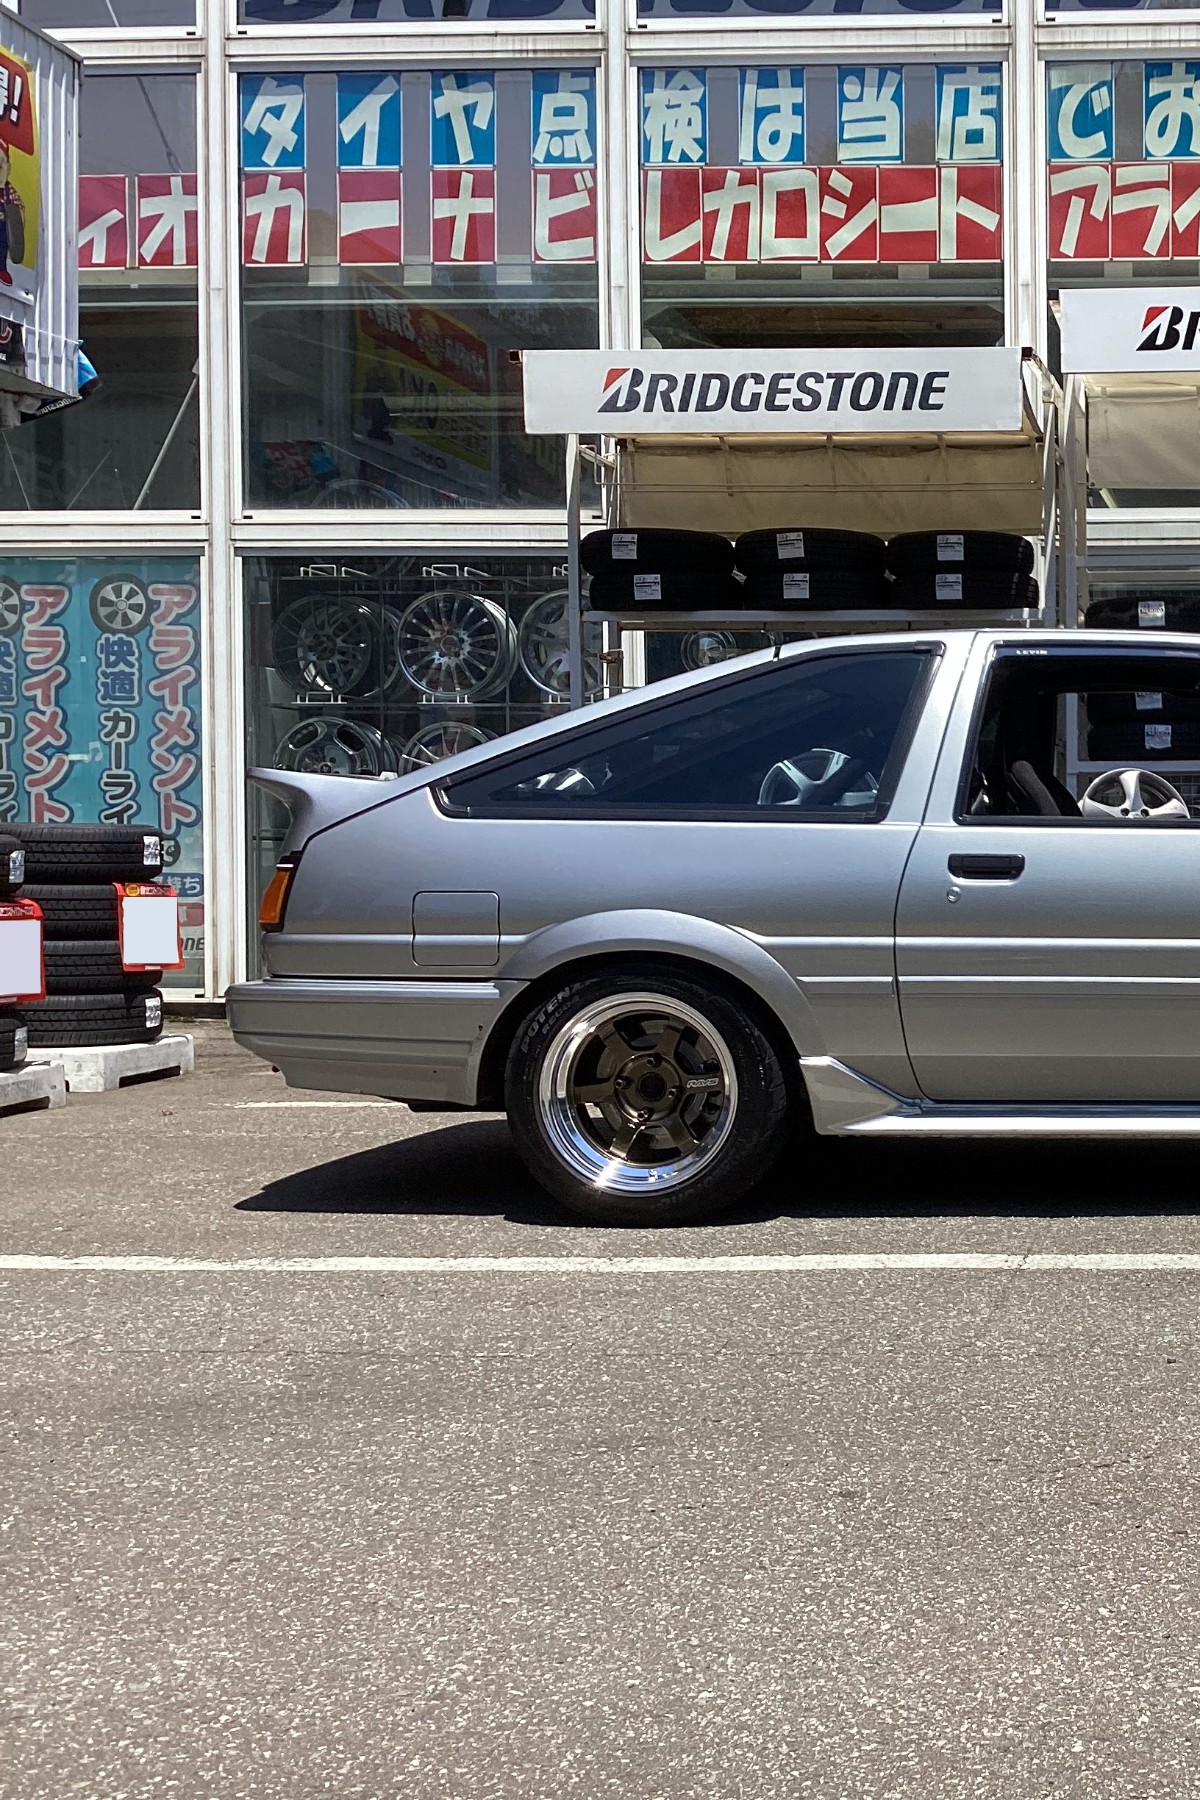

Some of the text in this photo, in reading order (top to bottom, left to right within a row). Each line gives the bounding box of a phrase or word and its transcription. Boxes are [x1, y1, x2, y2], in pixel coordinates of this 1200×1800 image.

[598, 367, 949, 413] BRIDGESTONE
[22, 585, 69, 823] アライメント
[150, 585, 196, 832] アライメント
[687, 1077, 719, 1088] RAYS
